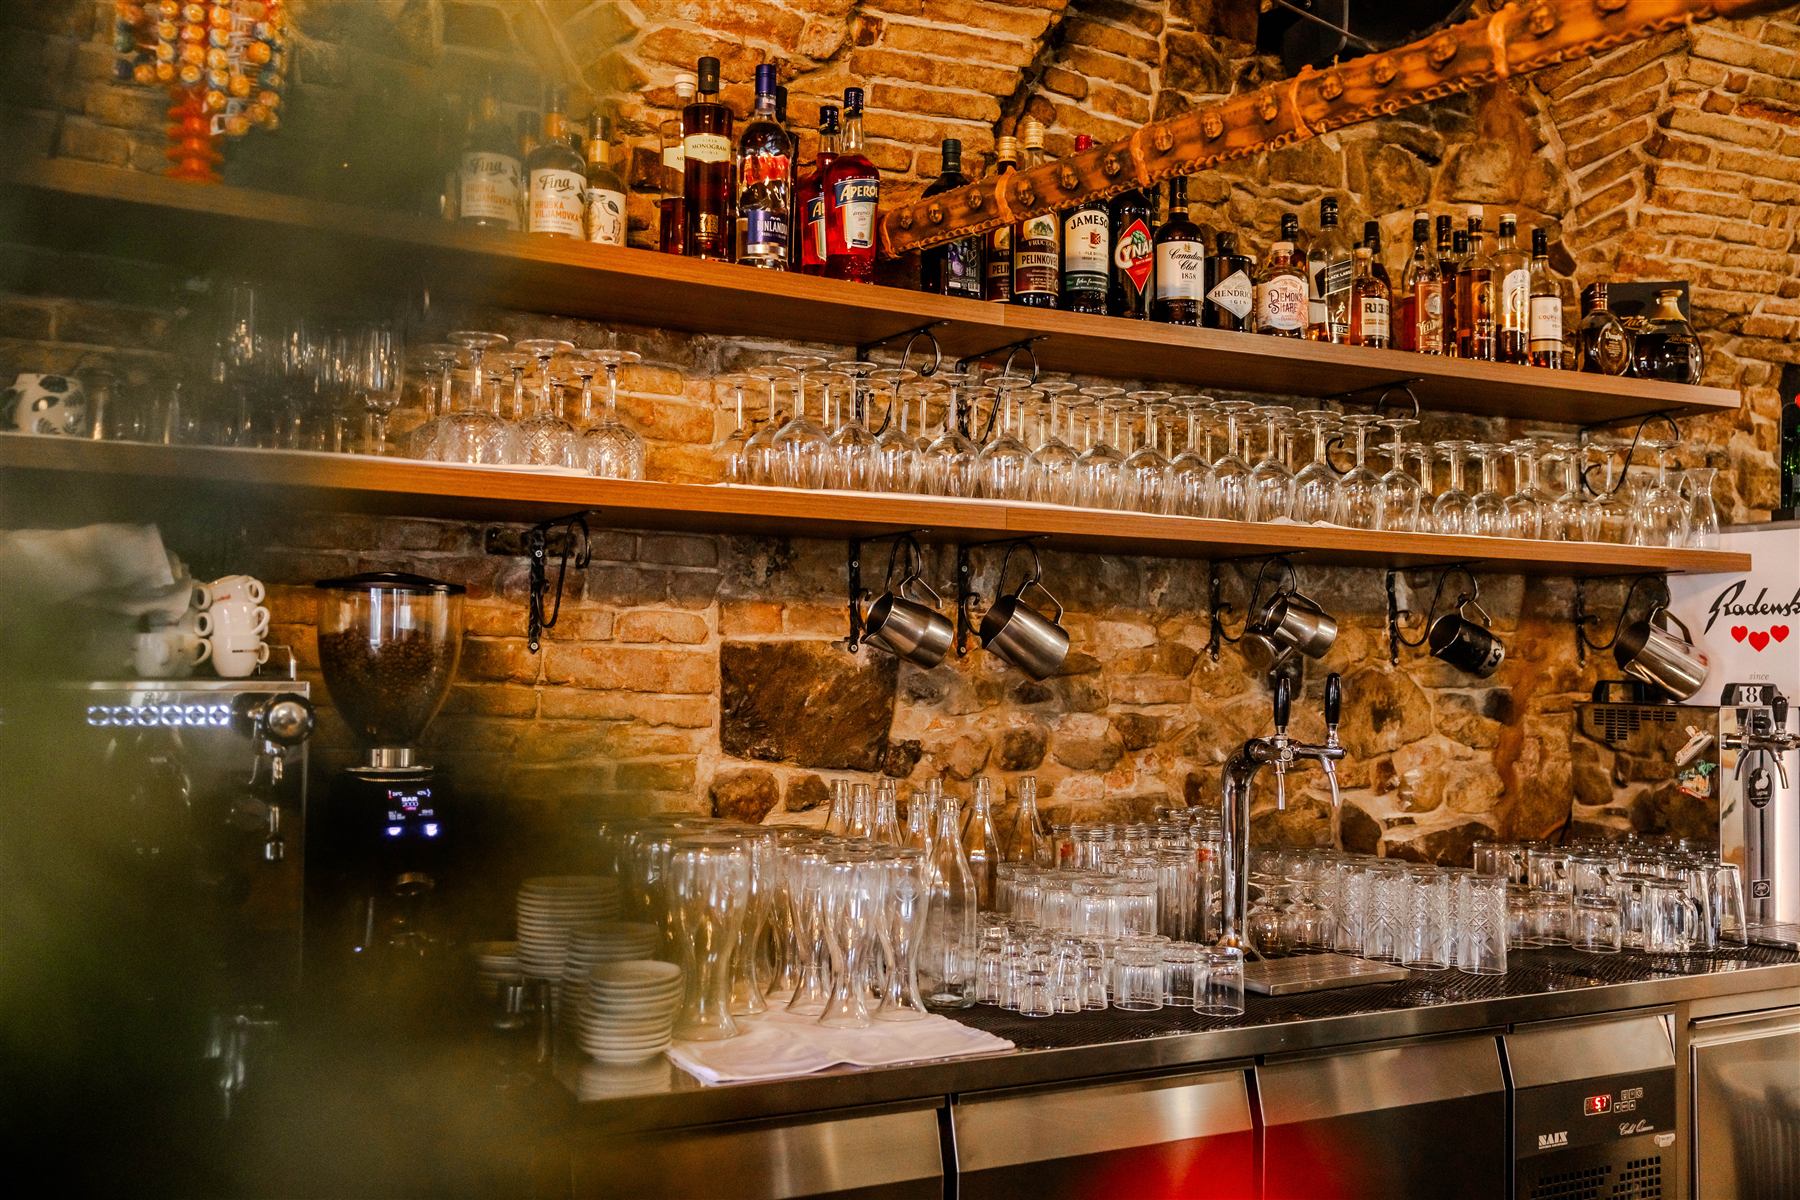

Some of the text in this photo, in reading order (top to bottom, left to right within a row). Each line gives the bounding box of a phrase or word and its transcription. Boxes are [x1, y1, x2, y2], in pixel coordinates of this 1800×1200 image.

[692, 144, 727, 152] MONOGRAM
[538, 174, 575, 192] Fina
[840, 184, 878, 201] APEROL
[1071, 215, 1108, 230] JAMESO
[1179, 260, 1198, 271] Club
[1214, 290, 1251, 298] HENDRIC
[1703, 579, 1800, 636] Radensk
[1748, 671, 1770, 681] since
